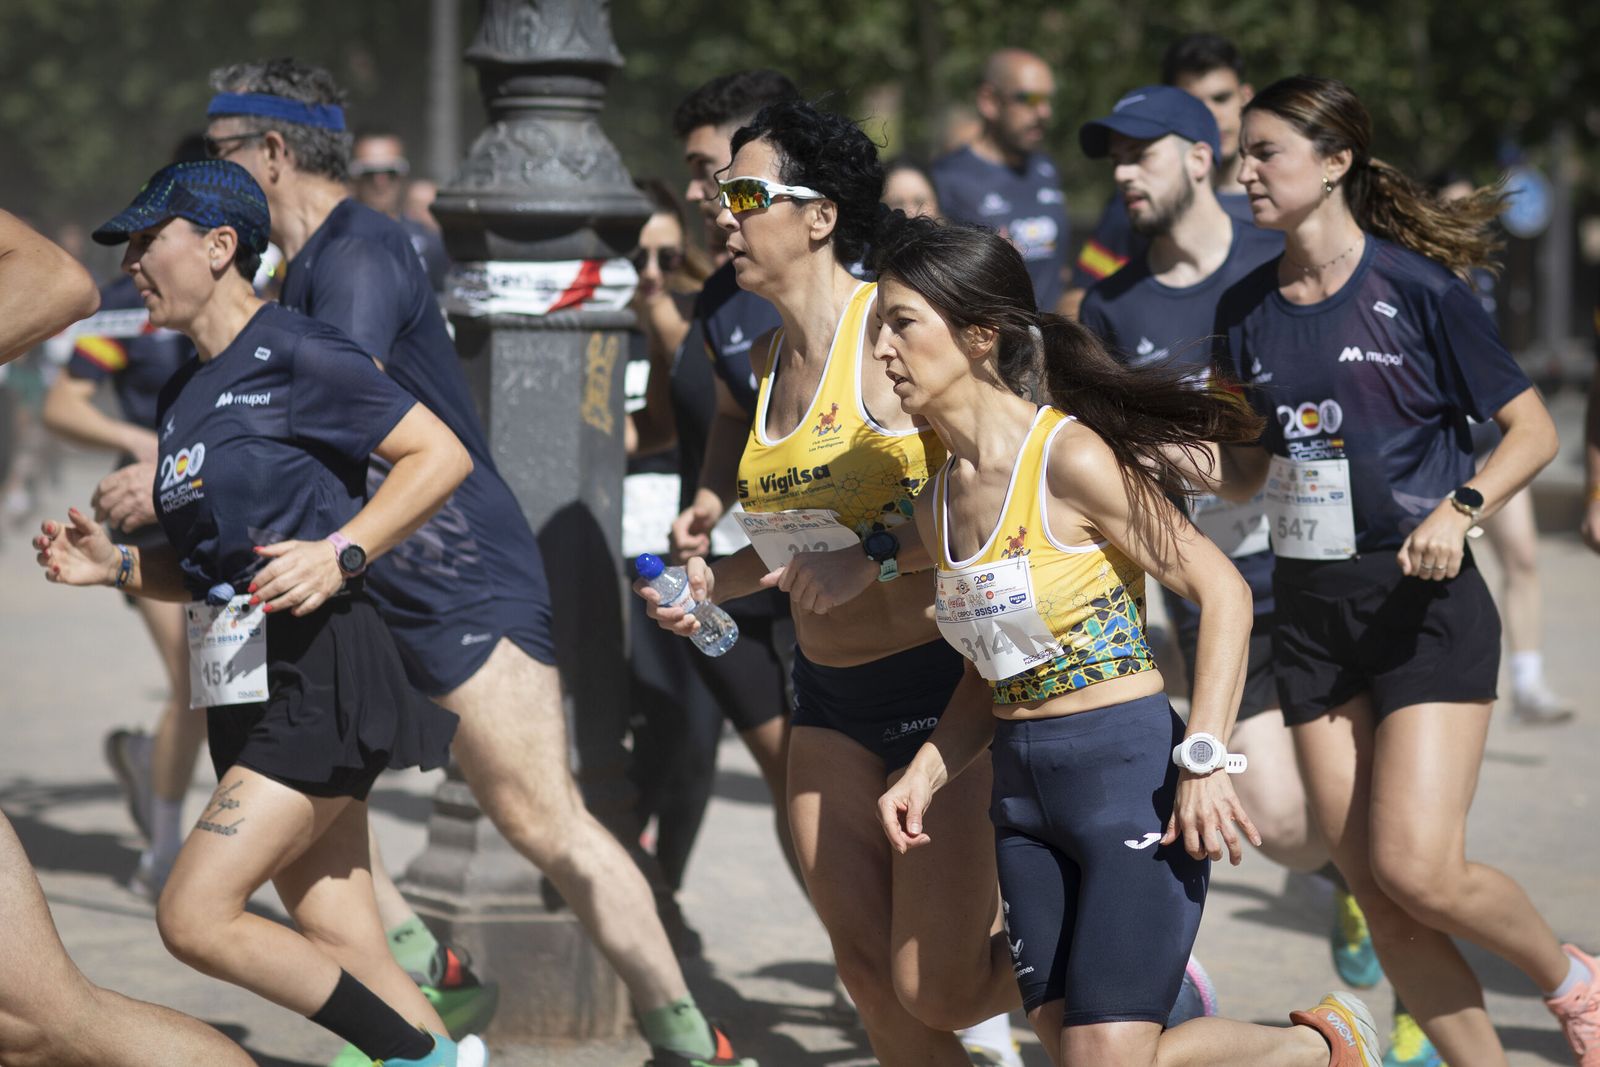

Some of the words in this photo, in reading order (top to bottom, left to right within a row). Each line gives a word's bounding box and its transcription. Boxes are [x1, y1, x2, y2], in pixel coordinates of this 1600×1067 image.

[1365, 351, 1404, 366] mupol
[234, 391, 271, 407] mupol
[1276, 399, 1343, 439] 200
[160, 442, 206, 491] 200
[760, 464, 831, 494] Vigilsa
[1277, 516, 1319, 541] 547
[973, 573, 995, 585] 200
[974, 604, 999, 617] asisa
[960, 629, 1014, 662] 314
[1327, 1011, 1356, 1047] HOKA
